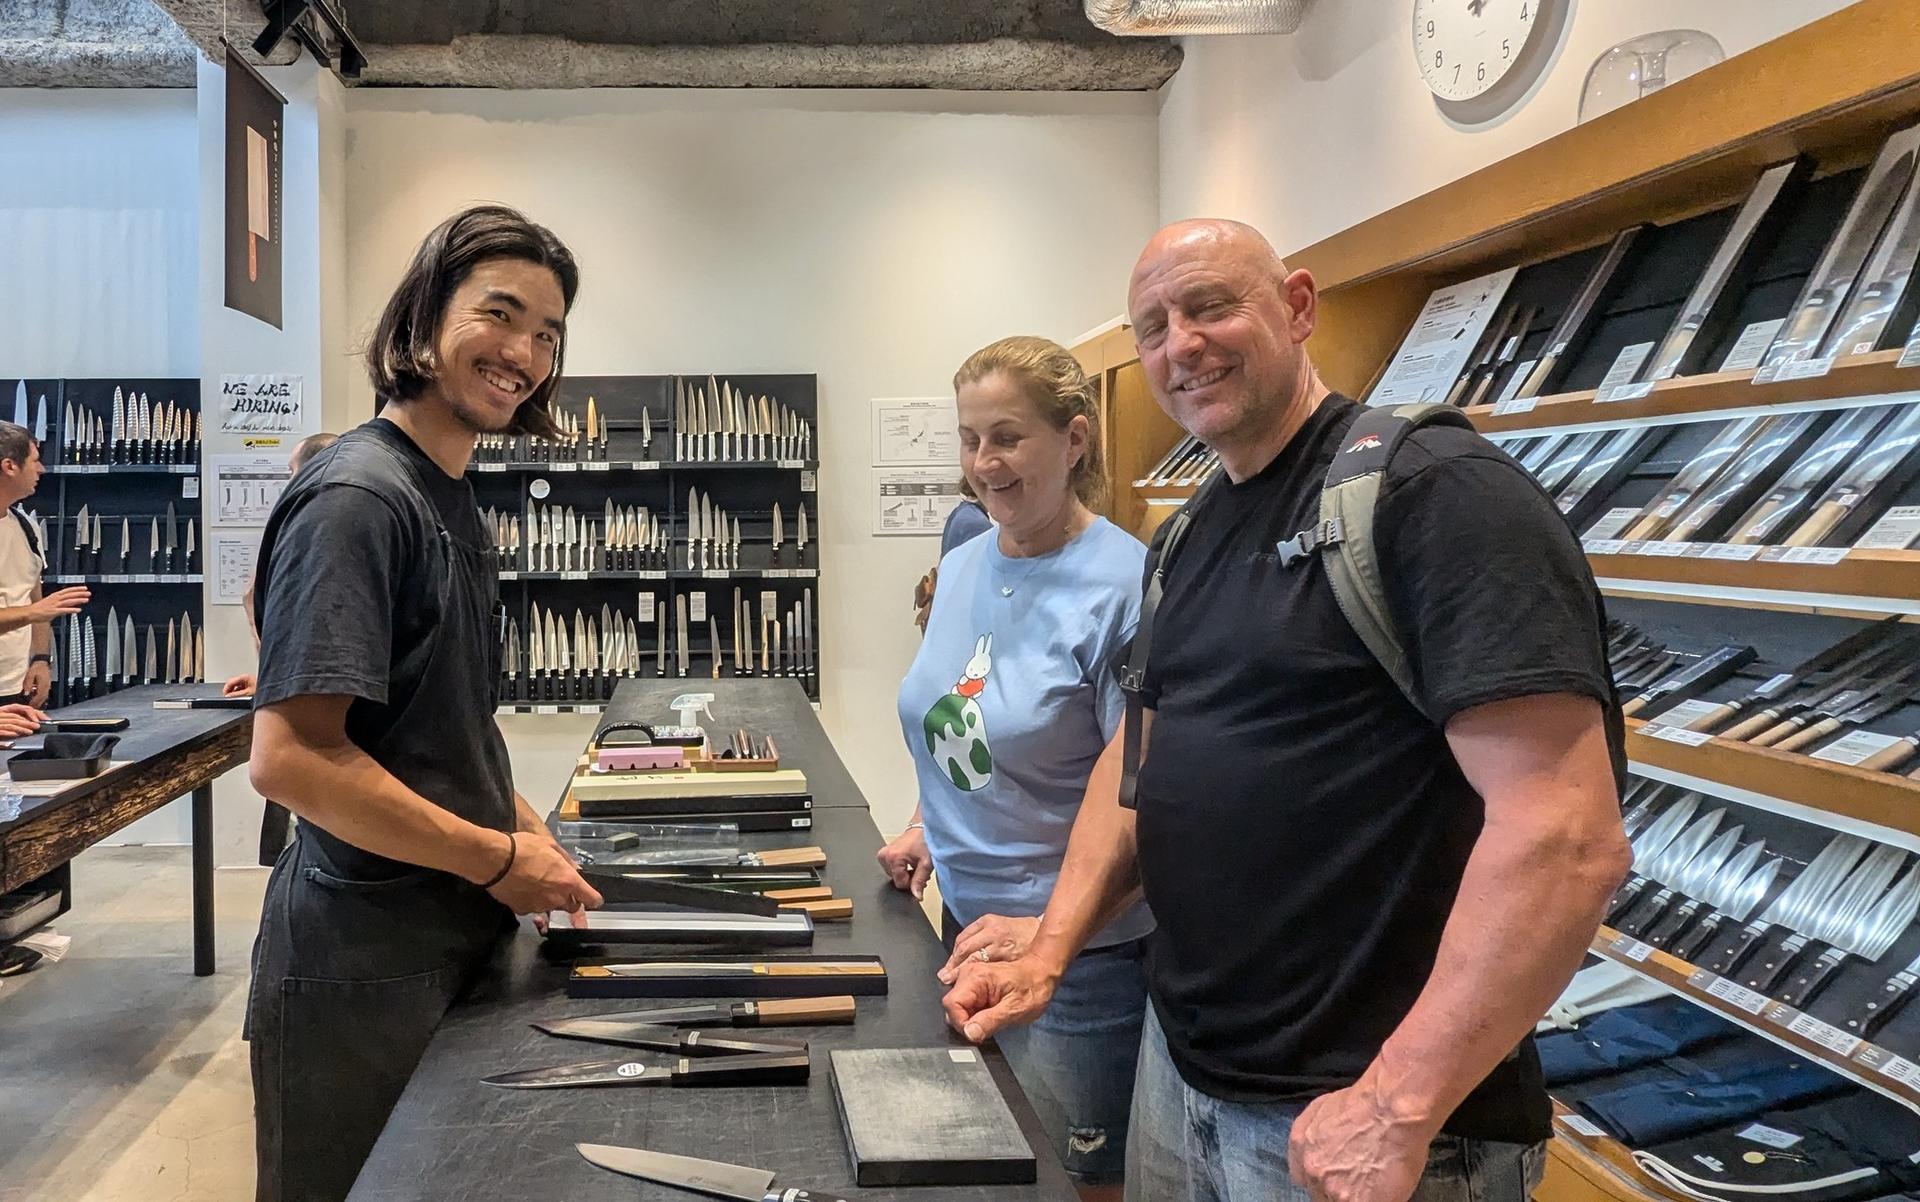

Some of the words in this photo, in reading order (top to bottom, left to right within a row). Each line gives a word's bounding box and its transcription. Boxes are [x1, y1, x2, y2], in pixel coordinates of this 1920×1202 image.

[1520, 2, 1528, 21] 4
[1427, 20, 1435, 38] 9
[1502, 39, 1510, 59] 5
[1435, 50, 1443, 68] 8
[1453, 64, 1461, 85] 7
[1477, 62, 1485, 81] 6
[223, 382, 248, 396] WE
[254, 382, 291, 397] ARE
[231, 398, 299, 415] HIRING!
